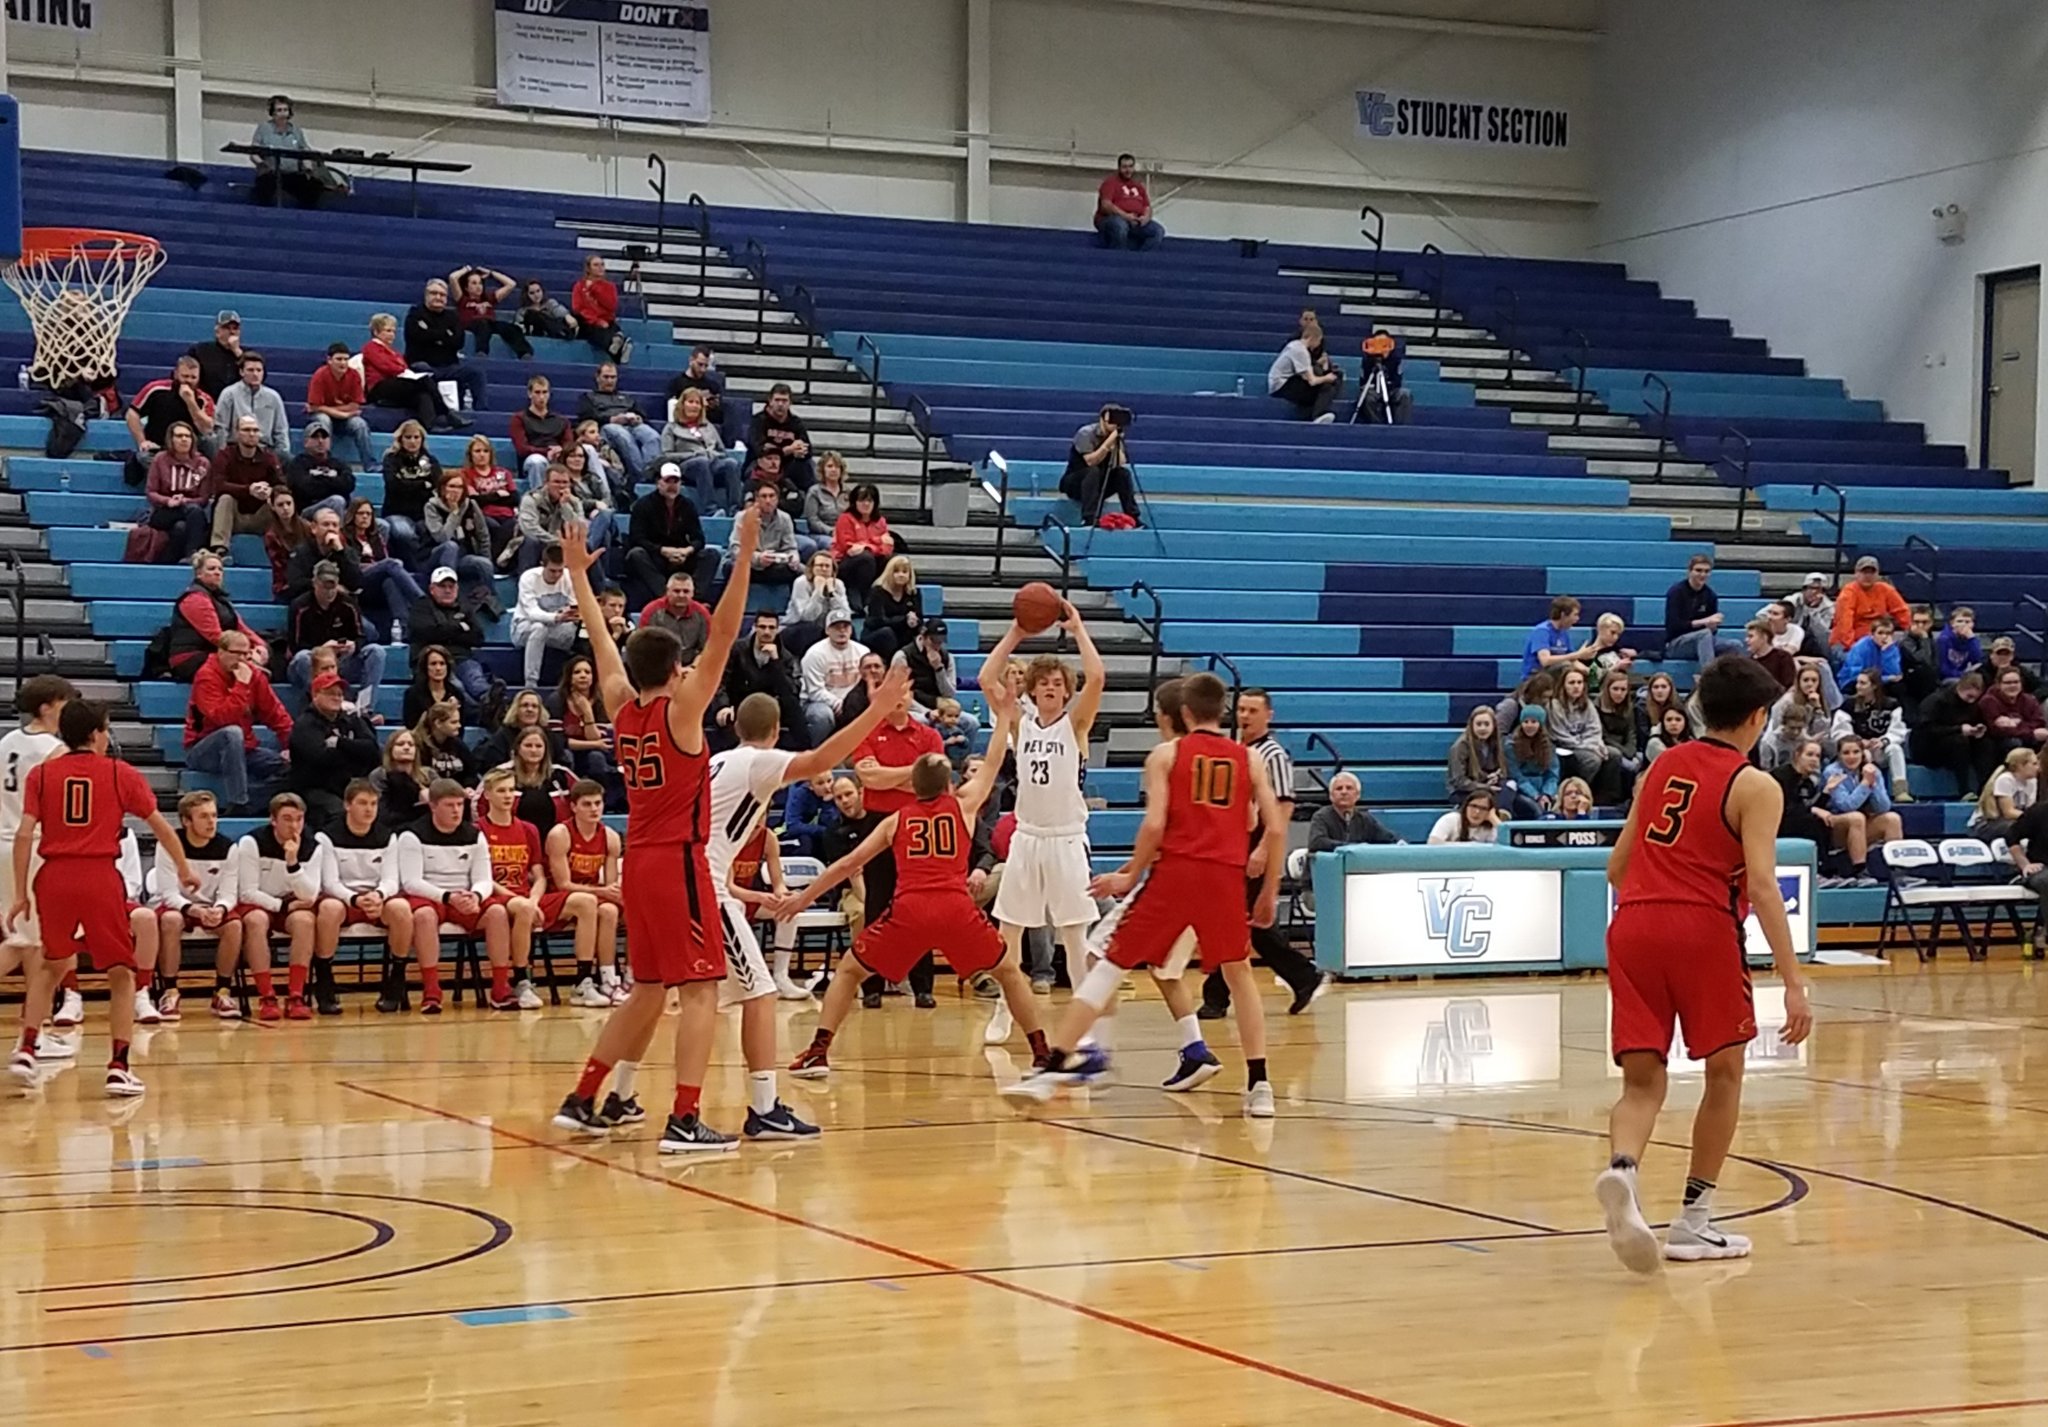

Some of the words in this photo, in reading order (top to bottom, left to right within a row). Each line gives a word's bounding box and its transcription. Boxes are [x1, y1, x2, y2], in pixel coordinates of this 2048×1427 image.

[524, 0, 551, 13] DO
[619, 4, 680, 25] DON'T
[1397, 99, 1483, 140] STUDENT
[1487, 106, 1567, 147] SECTION
[4, 752, 19, 792] 3
[618, 731, 666, 790] 55
[1031, 760, 1049, 785] 23
[1191, 754, 1239, 808] 10
[64, 776, 93, 827] 0
[1644, 775, 1698, 847] 3
[906, 812, 957, 859] 30
[1568, 832, 1597, 846] POSS
[1417, 877, 1493, 958] VC
